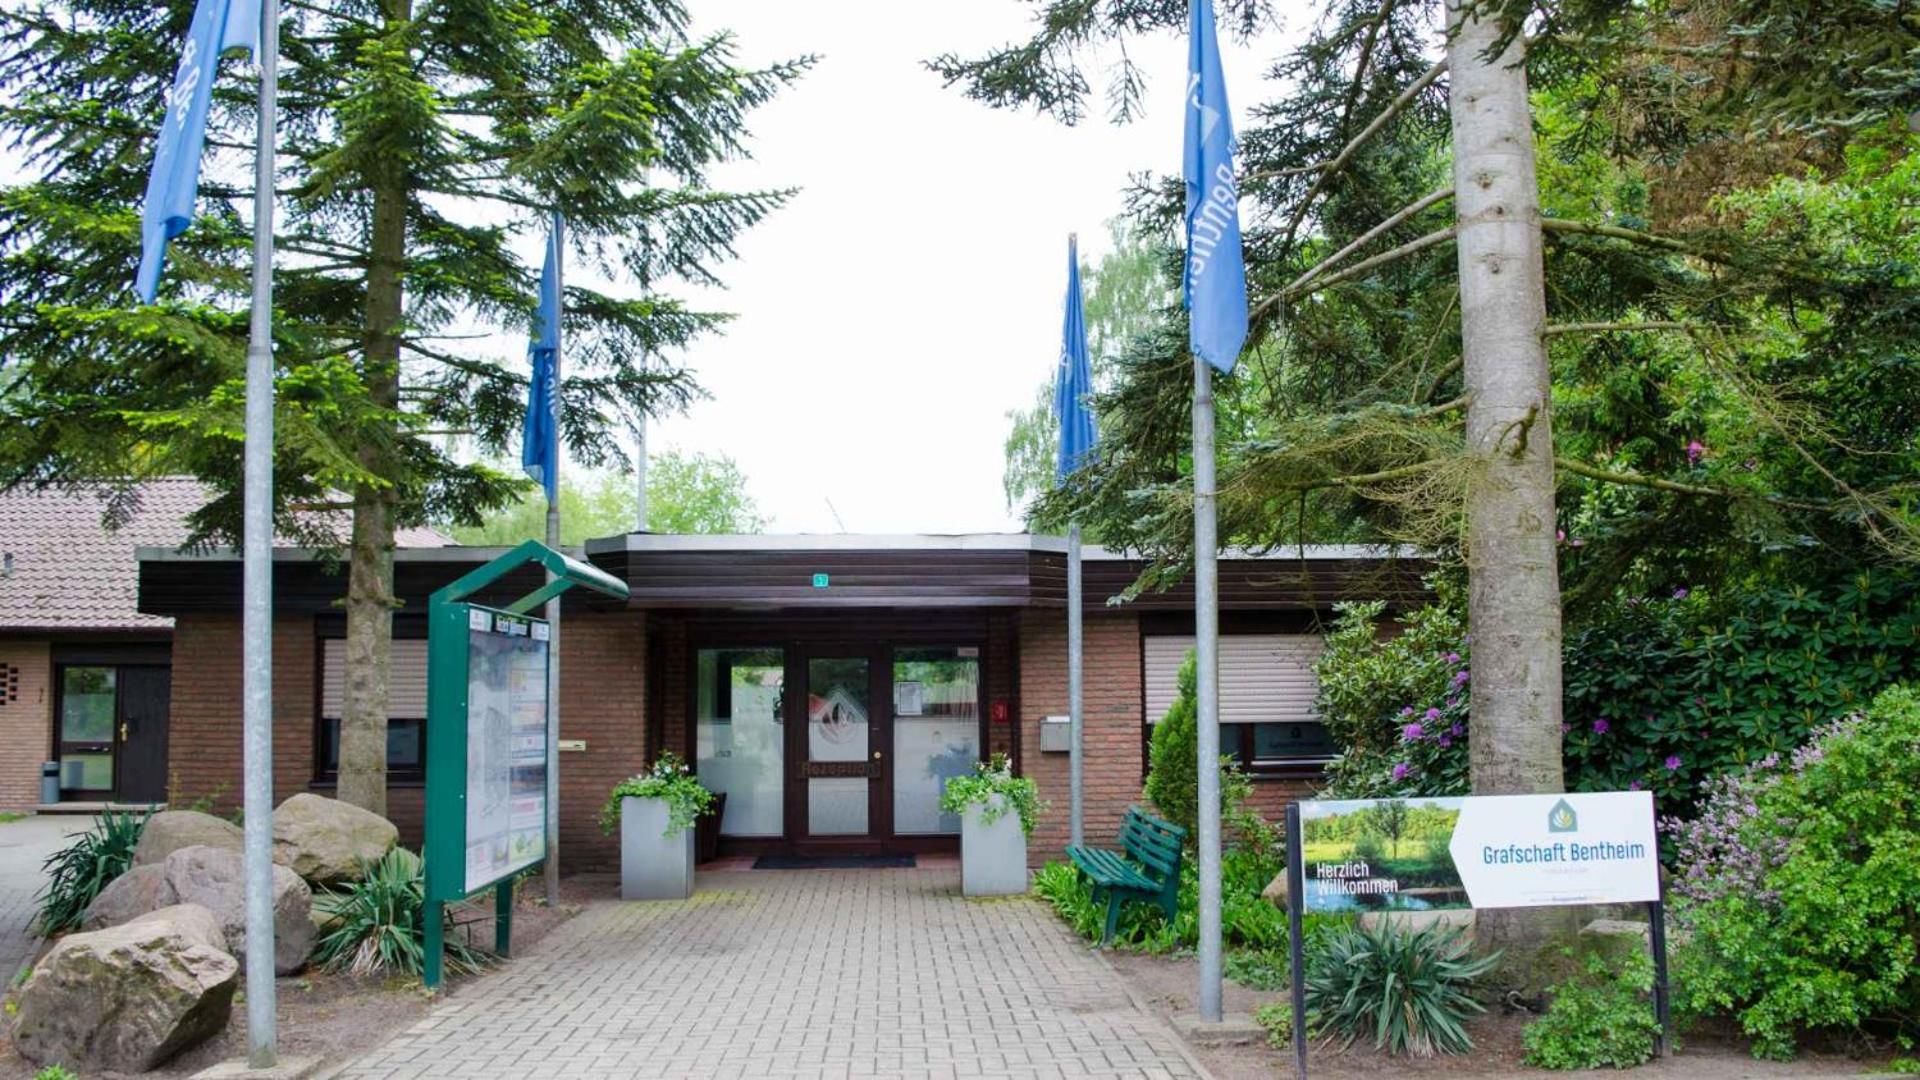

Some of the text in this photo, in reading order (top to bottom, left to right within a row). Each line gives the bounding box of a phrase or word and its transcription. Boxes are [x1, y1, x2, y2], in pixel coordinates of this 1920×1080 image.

[1484, 842, 1645, 865] Grafschaft Bentheim
[1316, 860, 1370, 878] Herzlich
[1317, 878, 1399, 896] Willkommen
